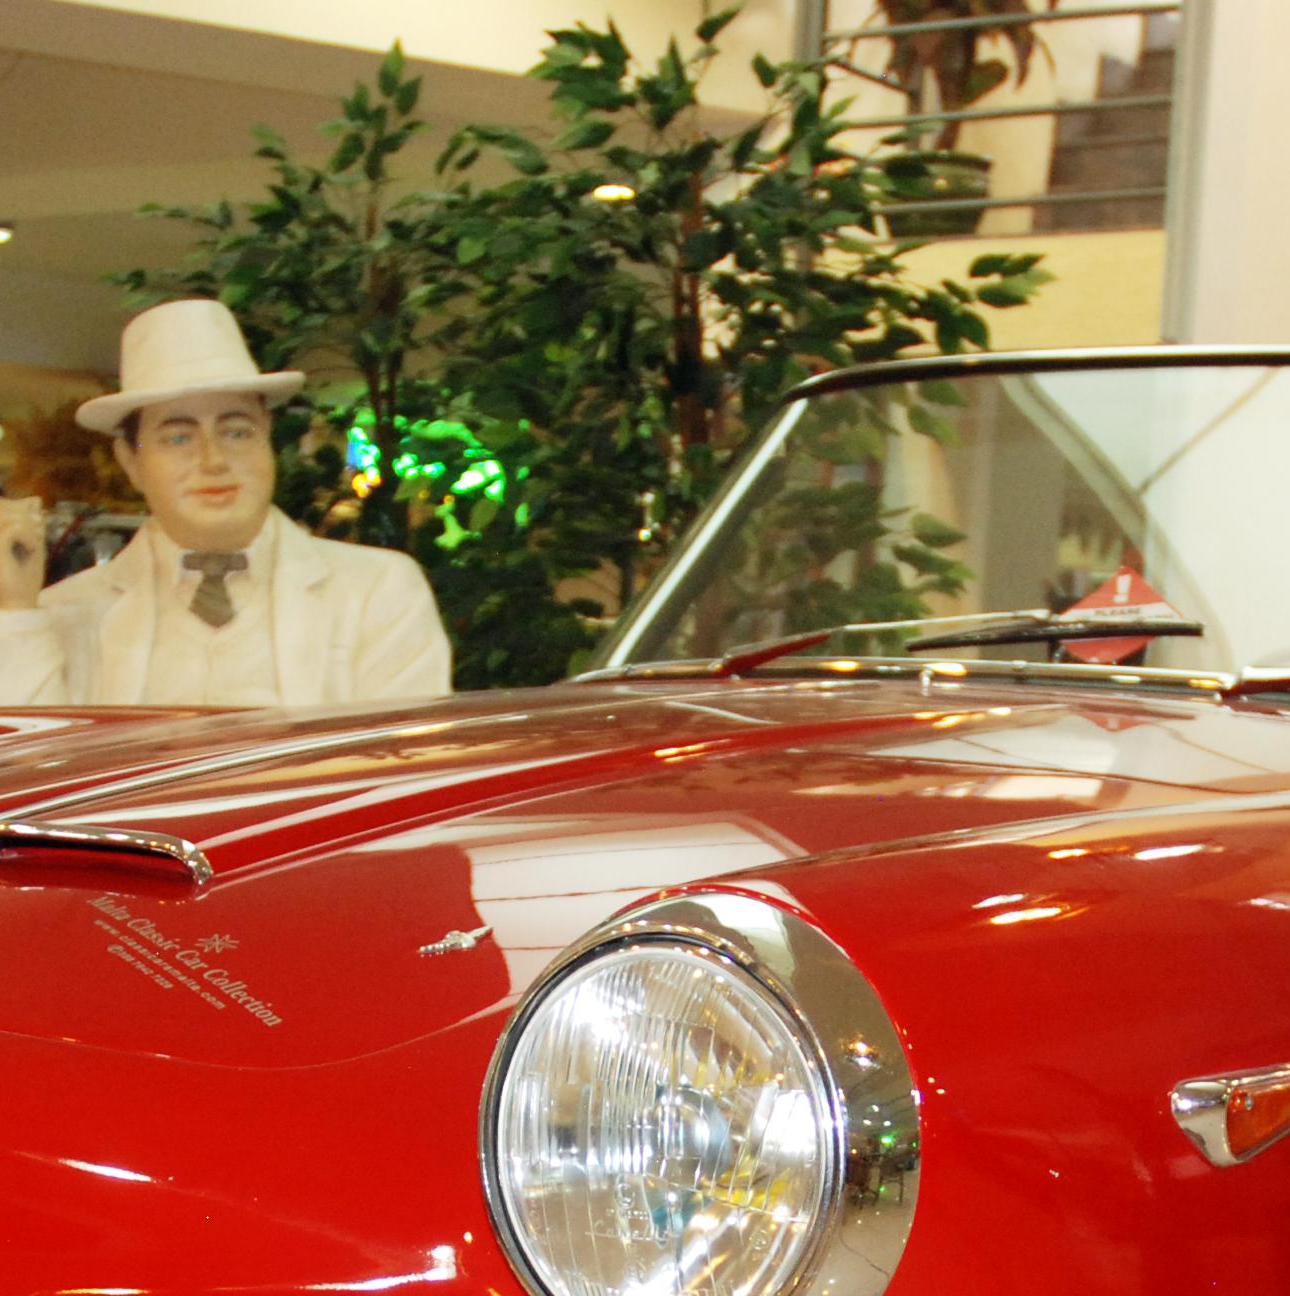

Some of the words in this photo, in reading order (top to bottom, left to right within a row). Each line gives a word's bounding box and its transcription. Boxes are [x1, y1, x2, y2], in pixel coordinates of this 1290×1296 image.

[86, 896, 131, 920] Malta
[127, 918, 181, 950] Classic
[175, 950, 209, 970] Car
[203, 968, 283, 1027] Collection
